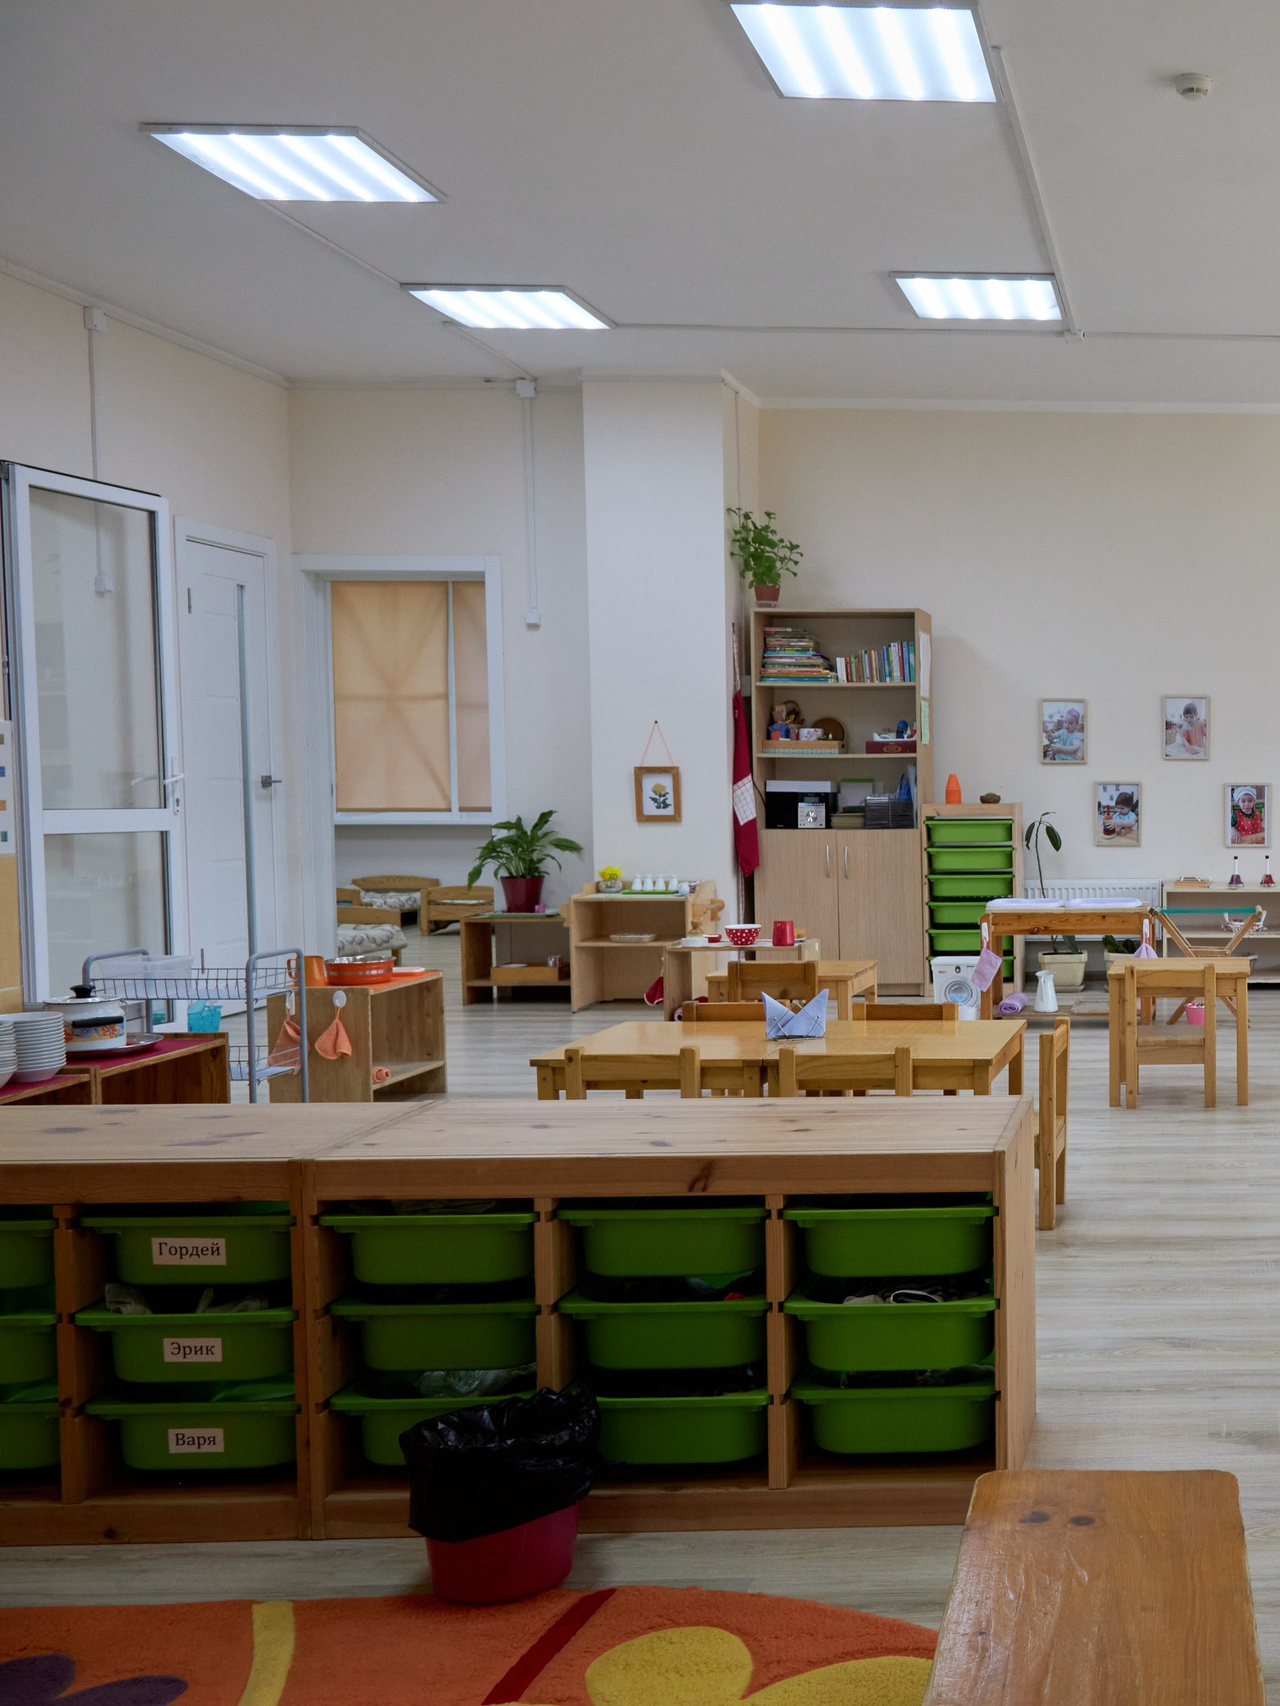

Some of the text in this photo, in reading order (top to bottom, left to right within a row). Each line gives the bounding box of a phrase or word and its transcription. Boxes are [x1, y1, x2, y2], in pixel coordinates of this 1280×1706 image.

[158, 1242, 221, 1260] Гордей
[170, 1341, 215, 1359] Эрик
[175, 1432, 217, 1450] Варя
